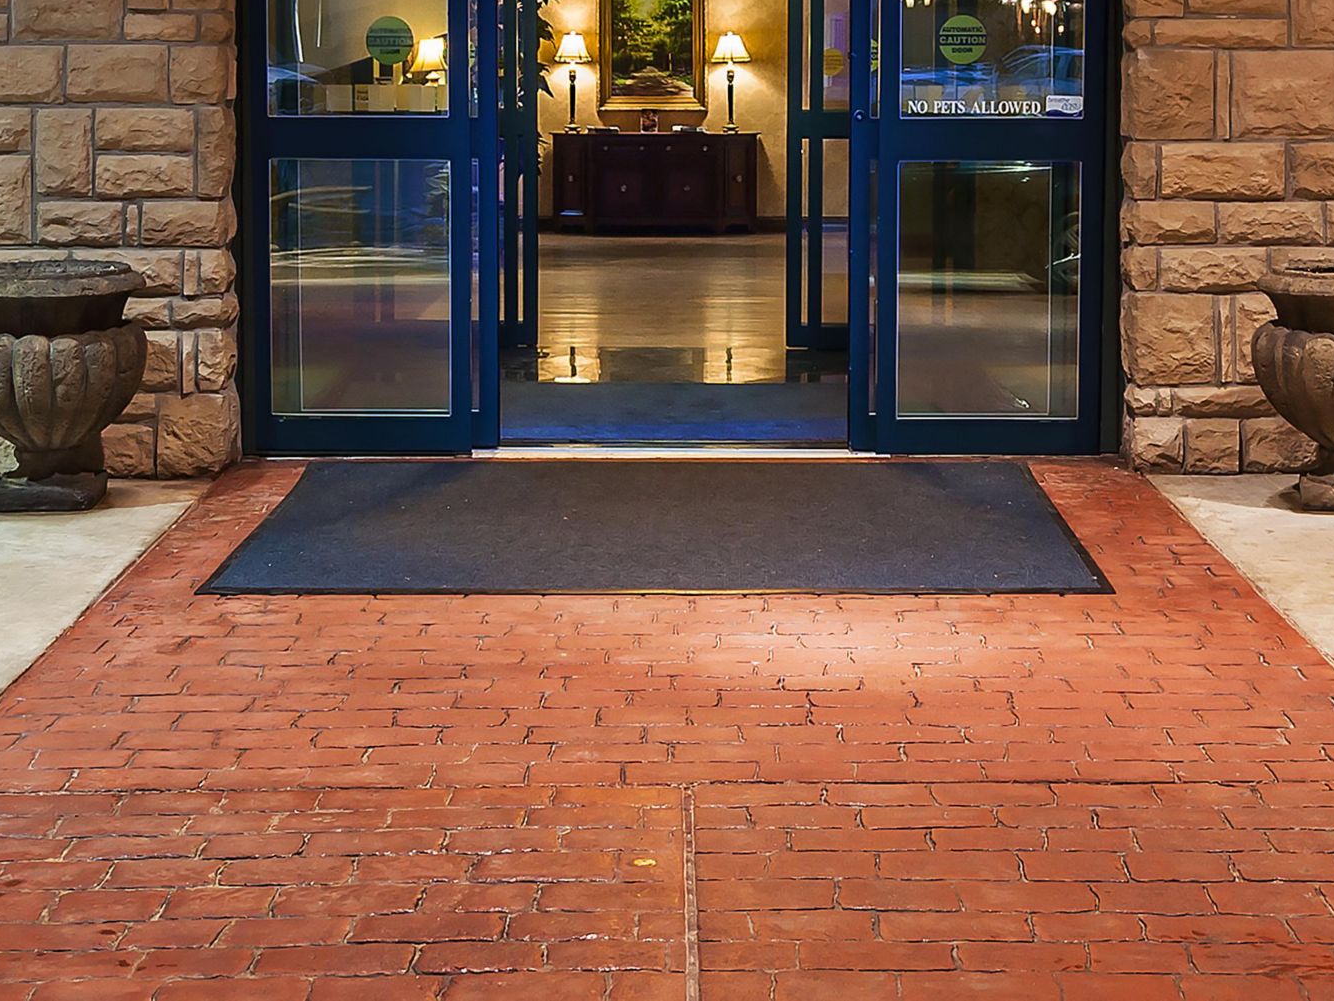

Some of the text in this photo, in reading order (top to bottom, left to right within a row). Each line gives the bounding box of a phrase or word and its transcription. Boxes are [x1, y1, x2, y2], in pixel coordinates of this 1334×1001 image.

[939, 36, 987, 44] CAUTION
[907, 101, 1041, 115] NO PETS ALLOWED
